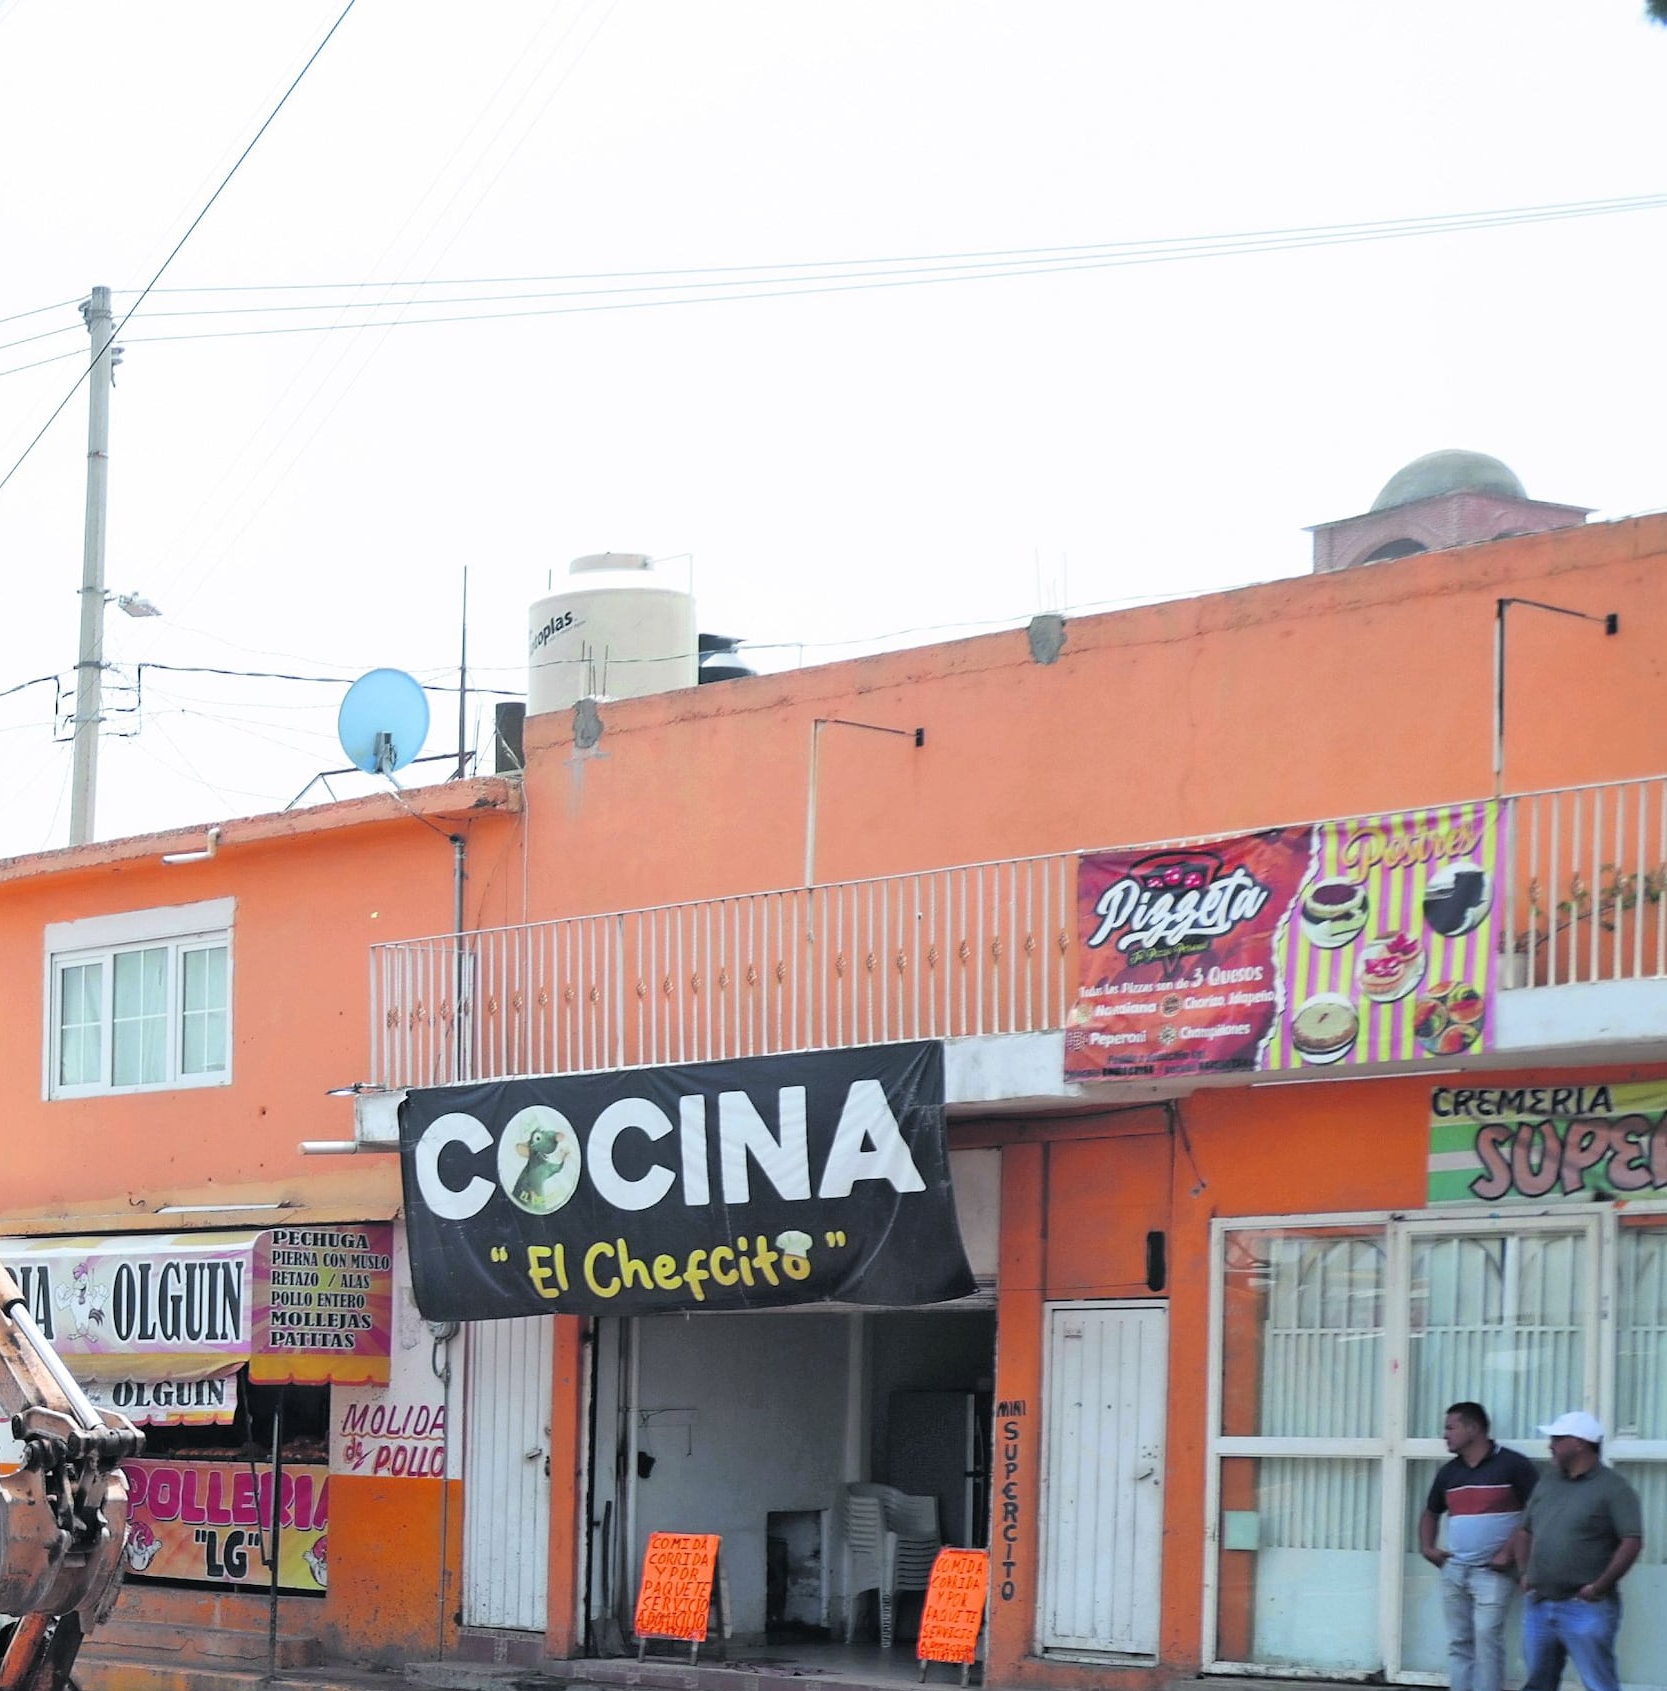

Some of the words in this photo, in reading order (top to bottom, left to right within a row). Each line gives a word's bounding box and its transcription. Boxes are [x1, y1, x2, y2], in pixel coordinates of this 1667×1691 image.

[1342, 825, 1484, 887] Postres
[1087, 867, 1268, 951] Pizzeta
[1191, 966, 1204, 987] 3
[1207, 965, 1264, 987] Quesos
[1089, 1030, 1147, 1048] Peperoni
[1432, 1086, 1613, 1117] CREMERIA
[271, 1230, 369, 1249] PECHUGA
[271, 1250, 319, 1267] PIERNA
[322, 1253, 348, 1268] CON
[351, 1254, 391, 1270] MUSLO
[271, 1271, 319, 1287] RETAZO
[340, 1274, 370, 1289] ALAS
[112, 1260, 245, 1341] OLGUIN
[270, 1291, 313, 1307] POLLO
[317, 1293, 365, 1309] ENTERO
[270, 1311, 372, 1329] MOLLEJAS
[270, 1331, 355, 1348] PATITAS
[112, 1379, 227, 1407] OLGUIN
[996, 1400, 1027, 1418] MINI
[342, 1404, 445, 1437] MOLIDA
[372, 1444, 445, 1478] POLLO
[1001, 1421, 1019, 1601] SUPERCITO
[194, 1529, 261, 1579] "LG"
[648, 1552, 709, 1567] CORRIDA
[654, 1565, 667, 1578] Y
[669, 1566, 700, 1580] POR
[935, 1557, 983, 1574] COMIDA
[643, 1580, 712, 1598] PAQUETE
[931, 1575, 980, 1590] CORRIDA
[642, 1595, 709, 1614] SERVICIO
[937, 1591, 945, 1604] Y
[946, 1591, 968, 1607] POR
[925, 1605, 978, 1624] PAQUETE
[922, 1623, 974, 1640] SERVICIO
